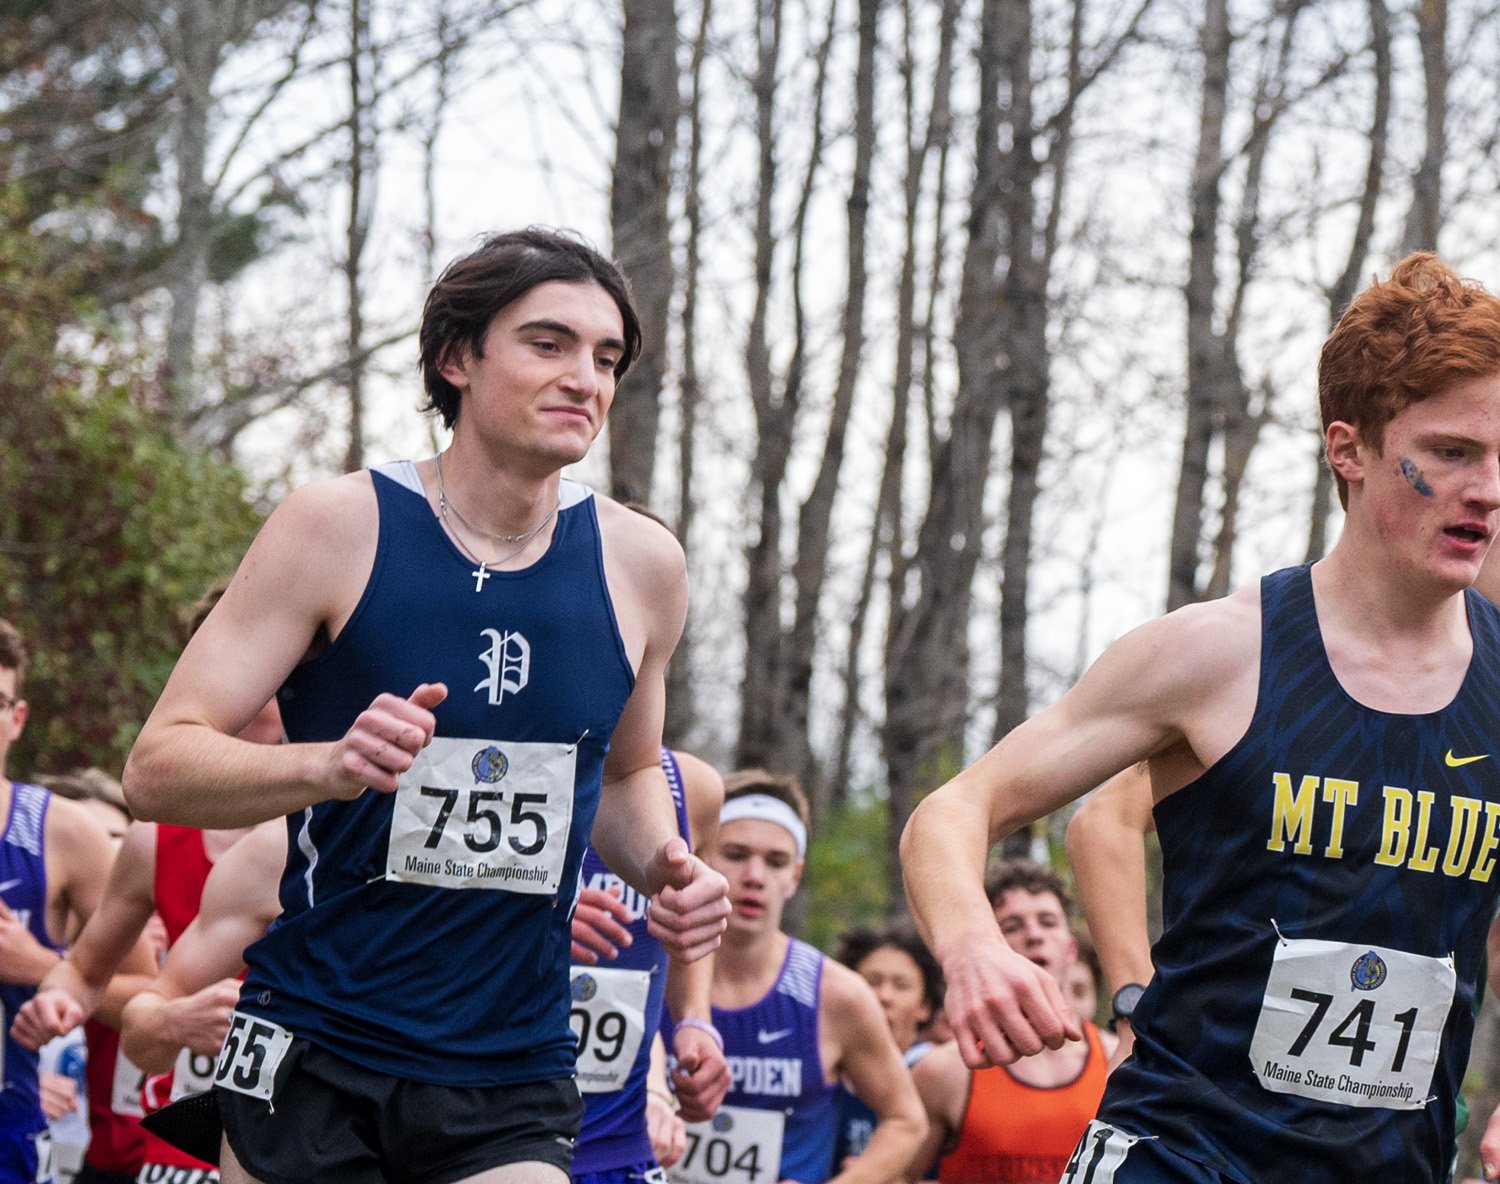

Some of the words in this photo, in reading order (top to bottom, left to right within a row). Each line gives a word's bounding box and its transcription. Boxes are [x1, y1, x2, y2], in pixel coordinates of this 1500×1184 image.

[474, 628, 531, 705] P
[420, 785, 548, 856] 755
[1266, 772, 1360, 859] MT
[404, 856, 441, 875] Maine
[444, 857, 474, 878] State
[476, 859, 549, 883] Championship
[1286, 987, 1419, 1073] 741
[1263, 1060, 1302, 1084] Maine
[1304, 1069, 1336, 1091] State
[1337, 1074, 1414, 1102] Championship
[682, 1132, 763, 1182] 704
